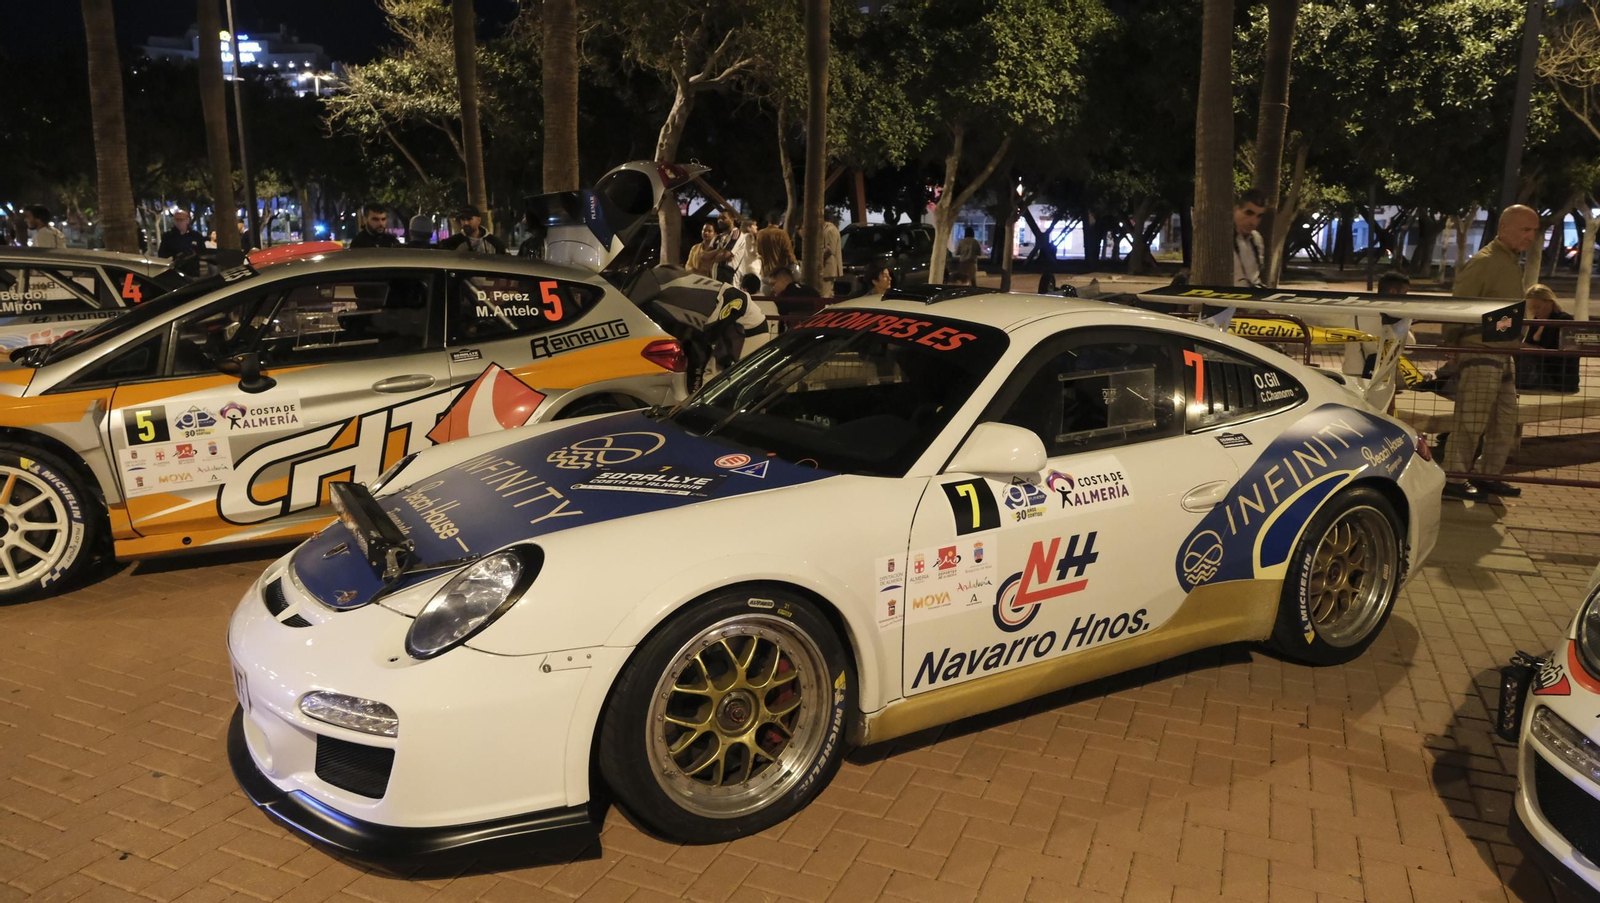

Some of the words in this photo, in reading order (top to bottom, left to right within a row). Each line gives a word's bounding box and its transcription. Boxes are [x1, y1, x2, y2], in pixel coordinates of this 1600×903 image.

[122, 273, 143, 303] 4
[477, 291, 491, 302] D.
[493, 290, 530, 302] Perez
[1179, 288, 1254, 300] Pro
[476, 304, 540, 318] M.Antelo
[539, 281, 564, 321] 5
[1236, 321, 1297, 340] Recalvi
[1183, 349, 1204, 406] 7
[1253, 371, 1281, 390] O.Gil
[1260, 386, 1295, 404] C.Chamorro
[243, 412, 299, 429] ALMERÍA
[250, 405, 282, 416] COSTA
[284, 404, 296, 413] DE
[135, 410, 156, 442] 5
[184, 429, 196, 438] 30
[1361, 445, 1392, 468] Beach
[158, 472, 194, 484] MOYA
[625, 473, 714, 485] RALLYE
[1077, 474, 1110, 488] COSTA
[1110, 471, 1124, 482] DE
[1225, 418, 1364, 535] INFINITY
[41, 470, 82, 519] MICHELIN
[453, 454, 584, 525] INFINITY
[1074, 482, 1130, 507] ALMERÍA
[955, 483, 981, 529] 7
[1015, 510, 1027, 522] 30
[420, 499, 461, 540] House
[1298, 553, 1312, 620] MICHELIN
[912, 591, 952, 610] MOYA
[911, 630, 1058, 690] Navarro
[1061, 608, 1151, 653] Hnos.
[797, 708, 844, 797] MICHELIN
